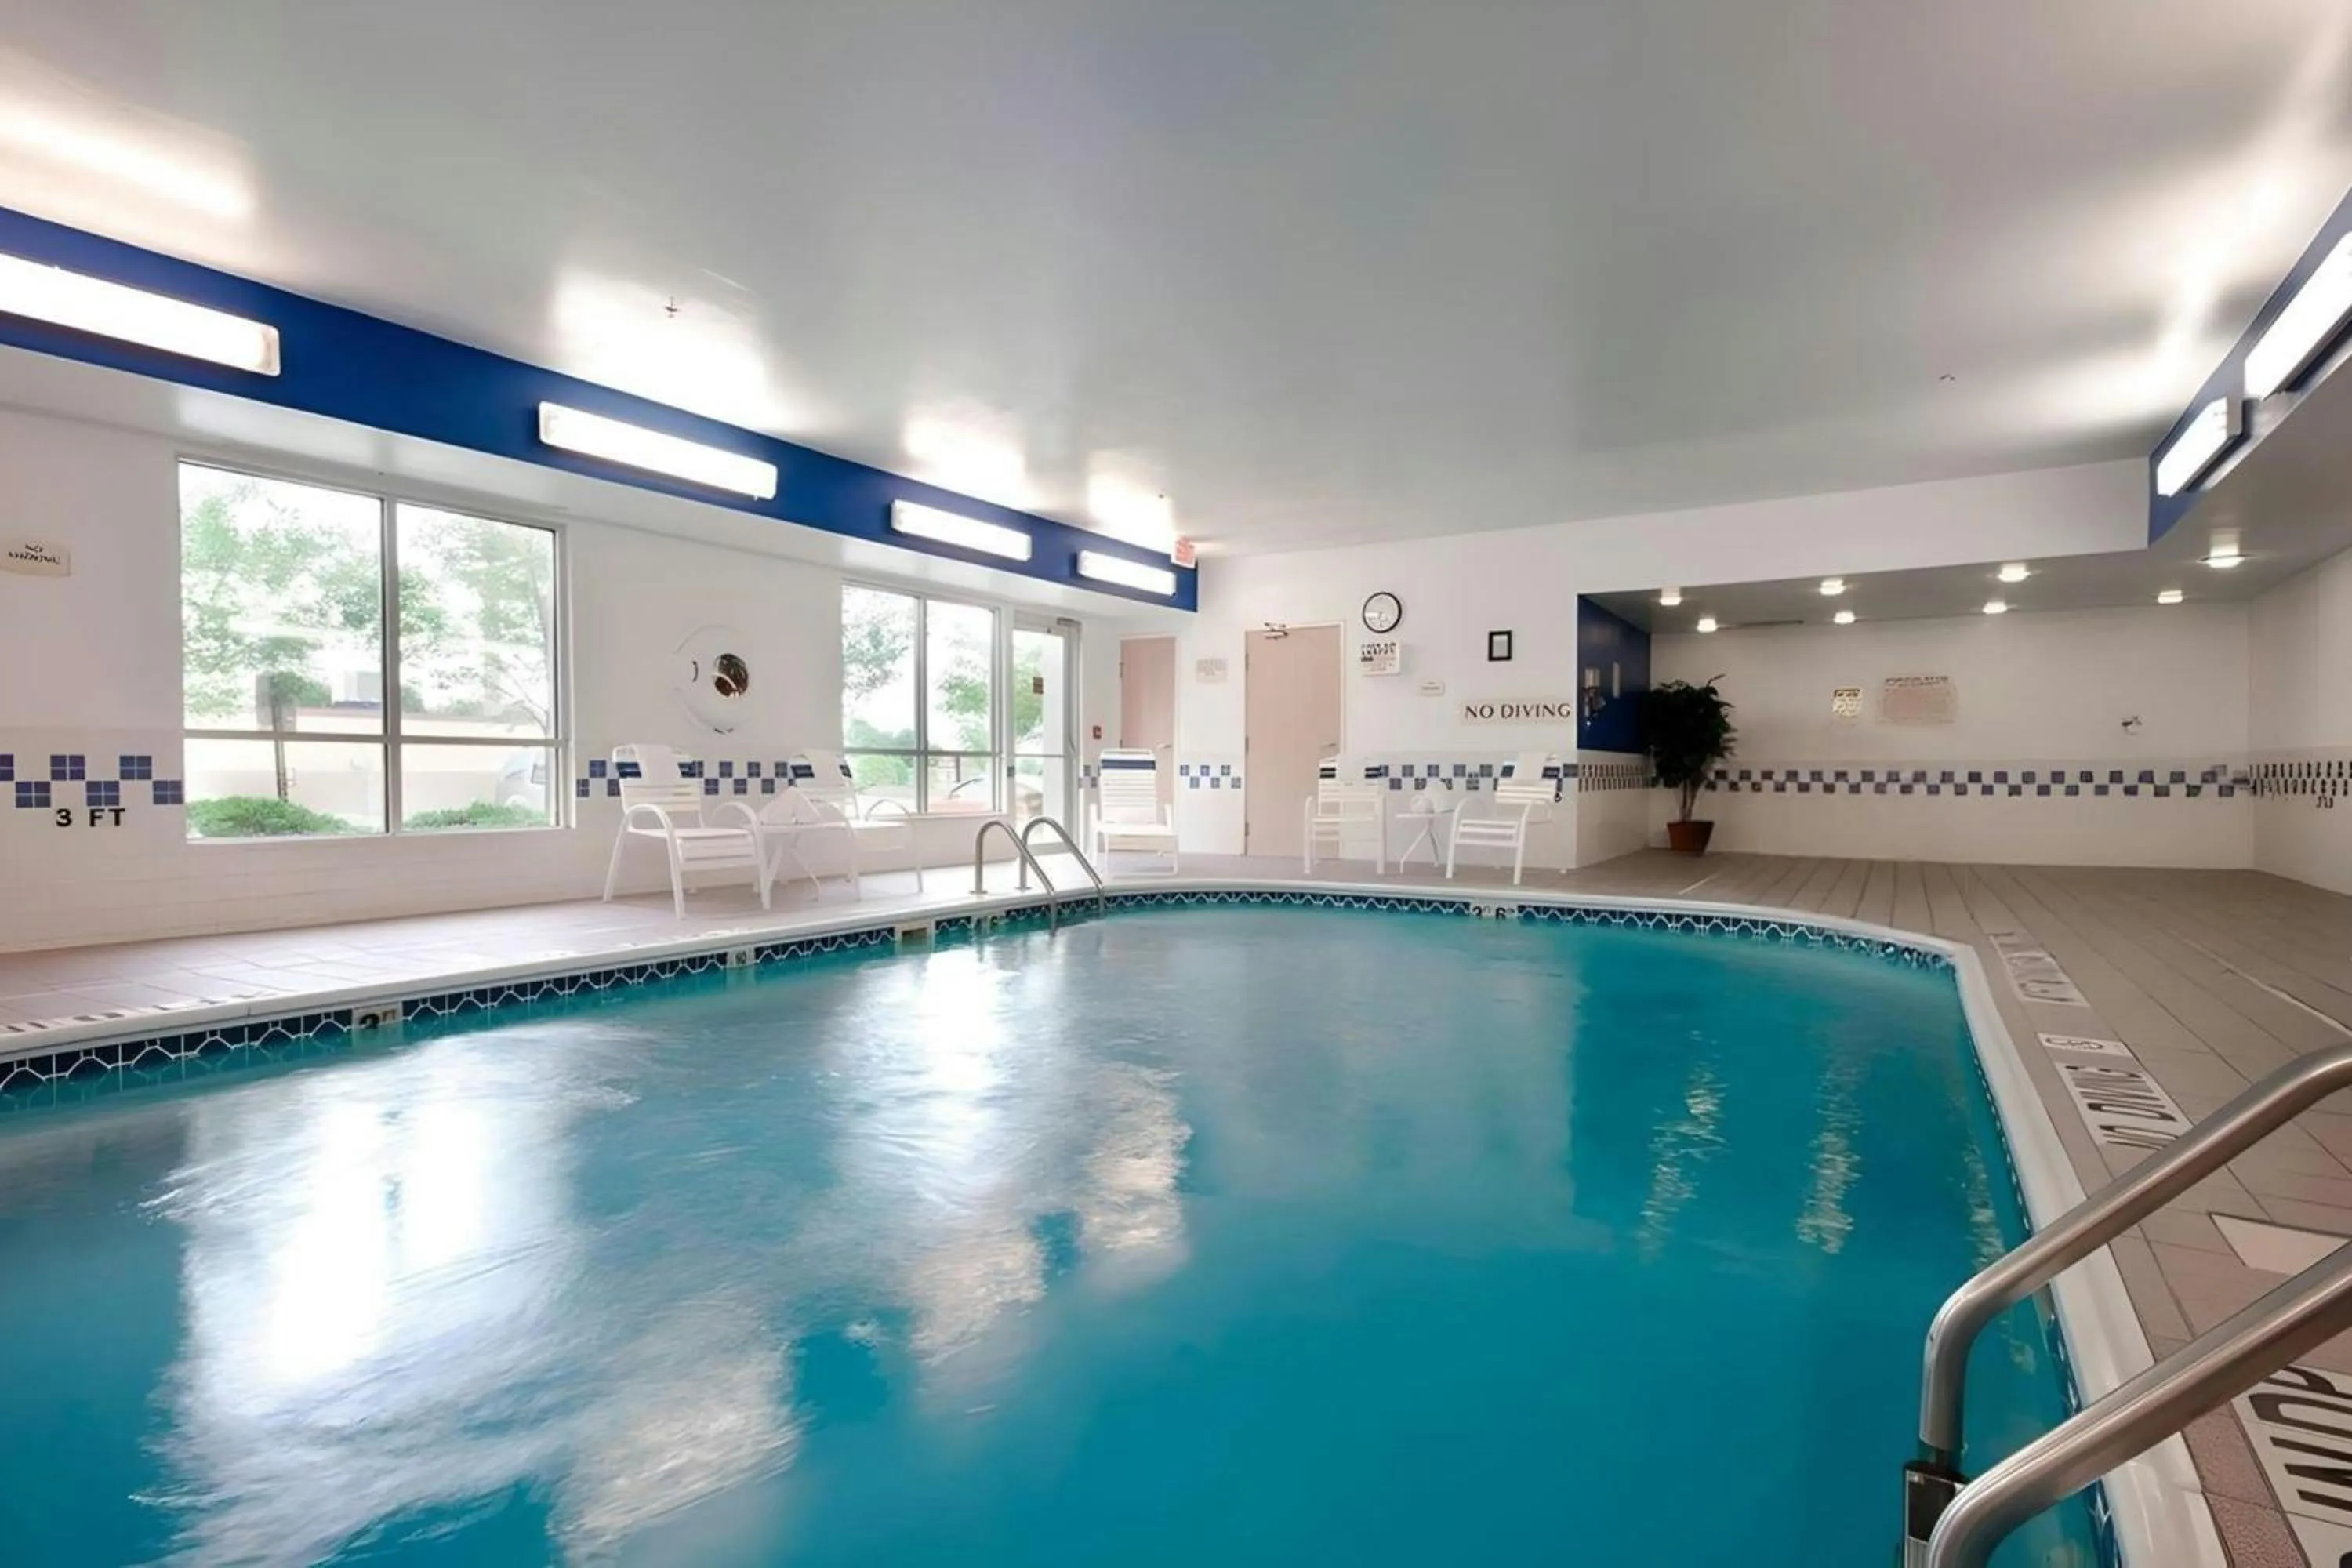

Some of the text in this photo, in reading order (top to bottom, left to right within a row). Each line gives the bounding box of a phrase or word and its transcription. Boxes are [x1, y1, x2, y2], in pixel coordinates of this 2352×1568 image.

[1465, 703, 1571, 719] NO DIVING
[56, 807, 126, 828] 3 FT
